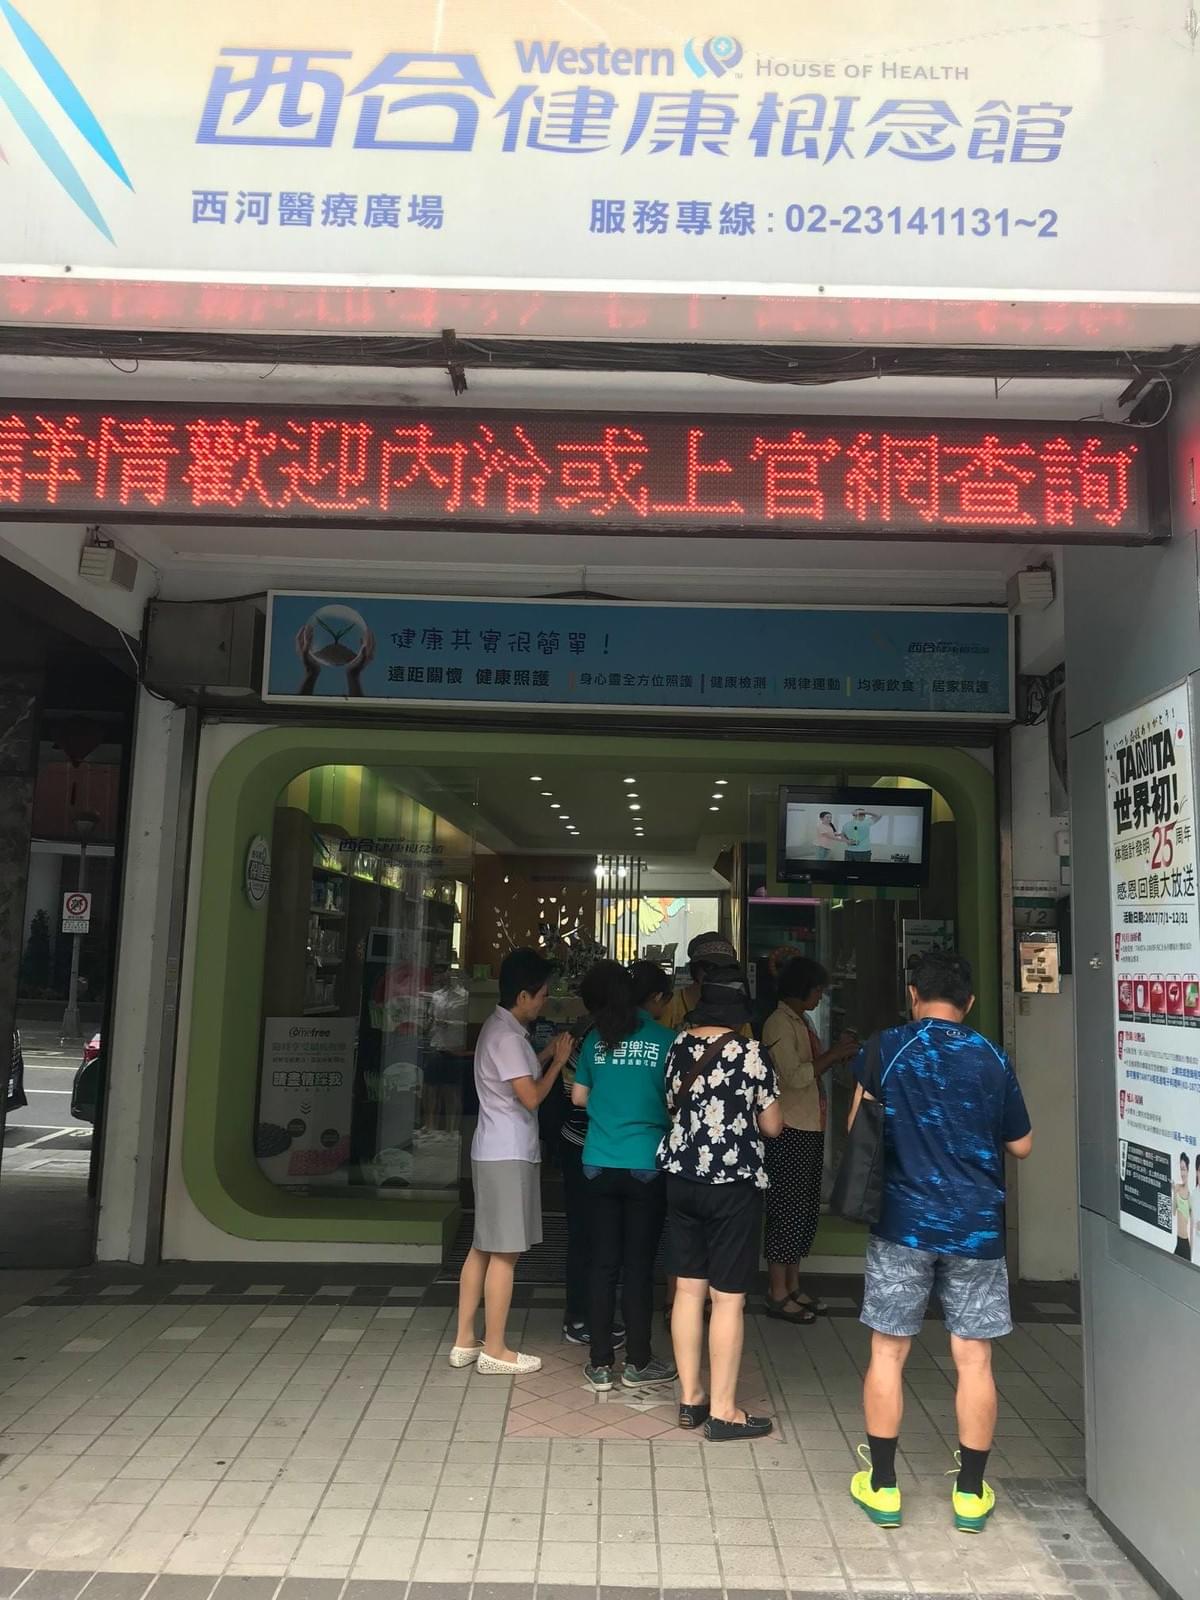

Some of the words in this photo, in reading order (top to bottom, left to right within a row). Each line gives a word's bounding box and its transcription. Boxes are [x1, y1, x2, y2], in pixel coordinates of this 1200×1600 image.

[514, 39, 675, 77] Western
[195, 47, 1073, 166] 西合健康概念館
[192, 190, 445, 229] 西河醫療廣場
[388, 666, 463, 684] 遠距關懷
[475, 667, 550, 687] 健康照護
[580, 672, 693, 688] 身心靈全方位照護
[710, 675, 767, 690] 健康檢測
[783, 676, 841, 691] 規律運動
[857, 678, 915, 693] 均衡飲食
[932, 679, 990, 694] 居家照護
[1116, 728, 1176, 785] TANITA
